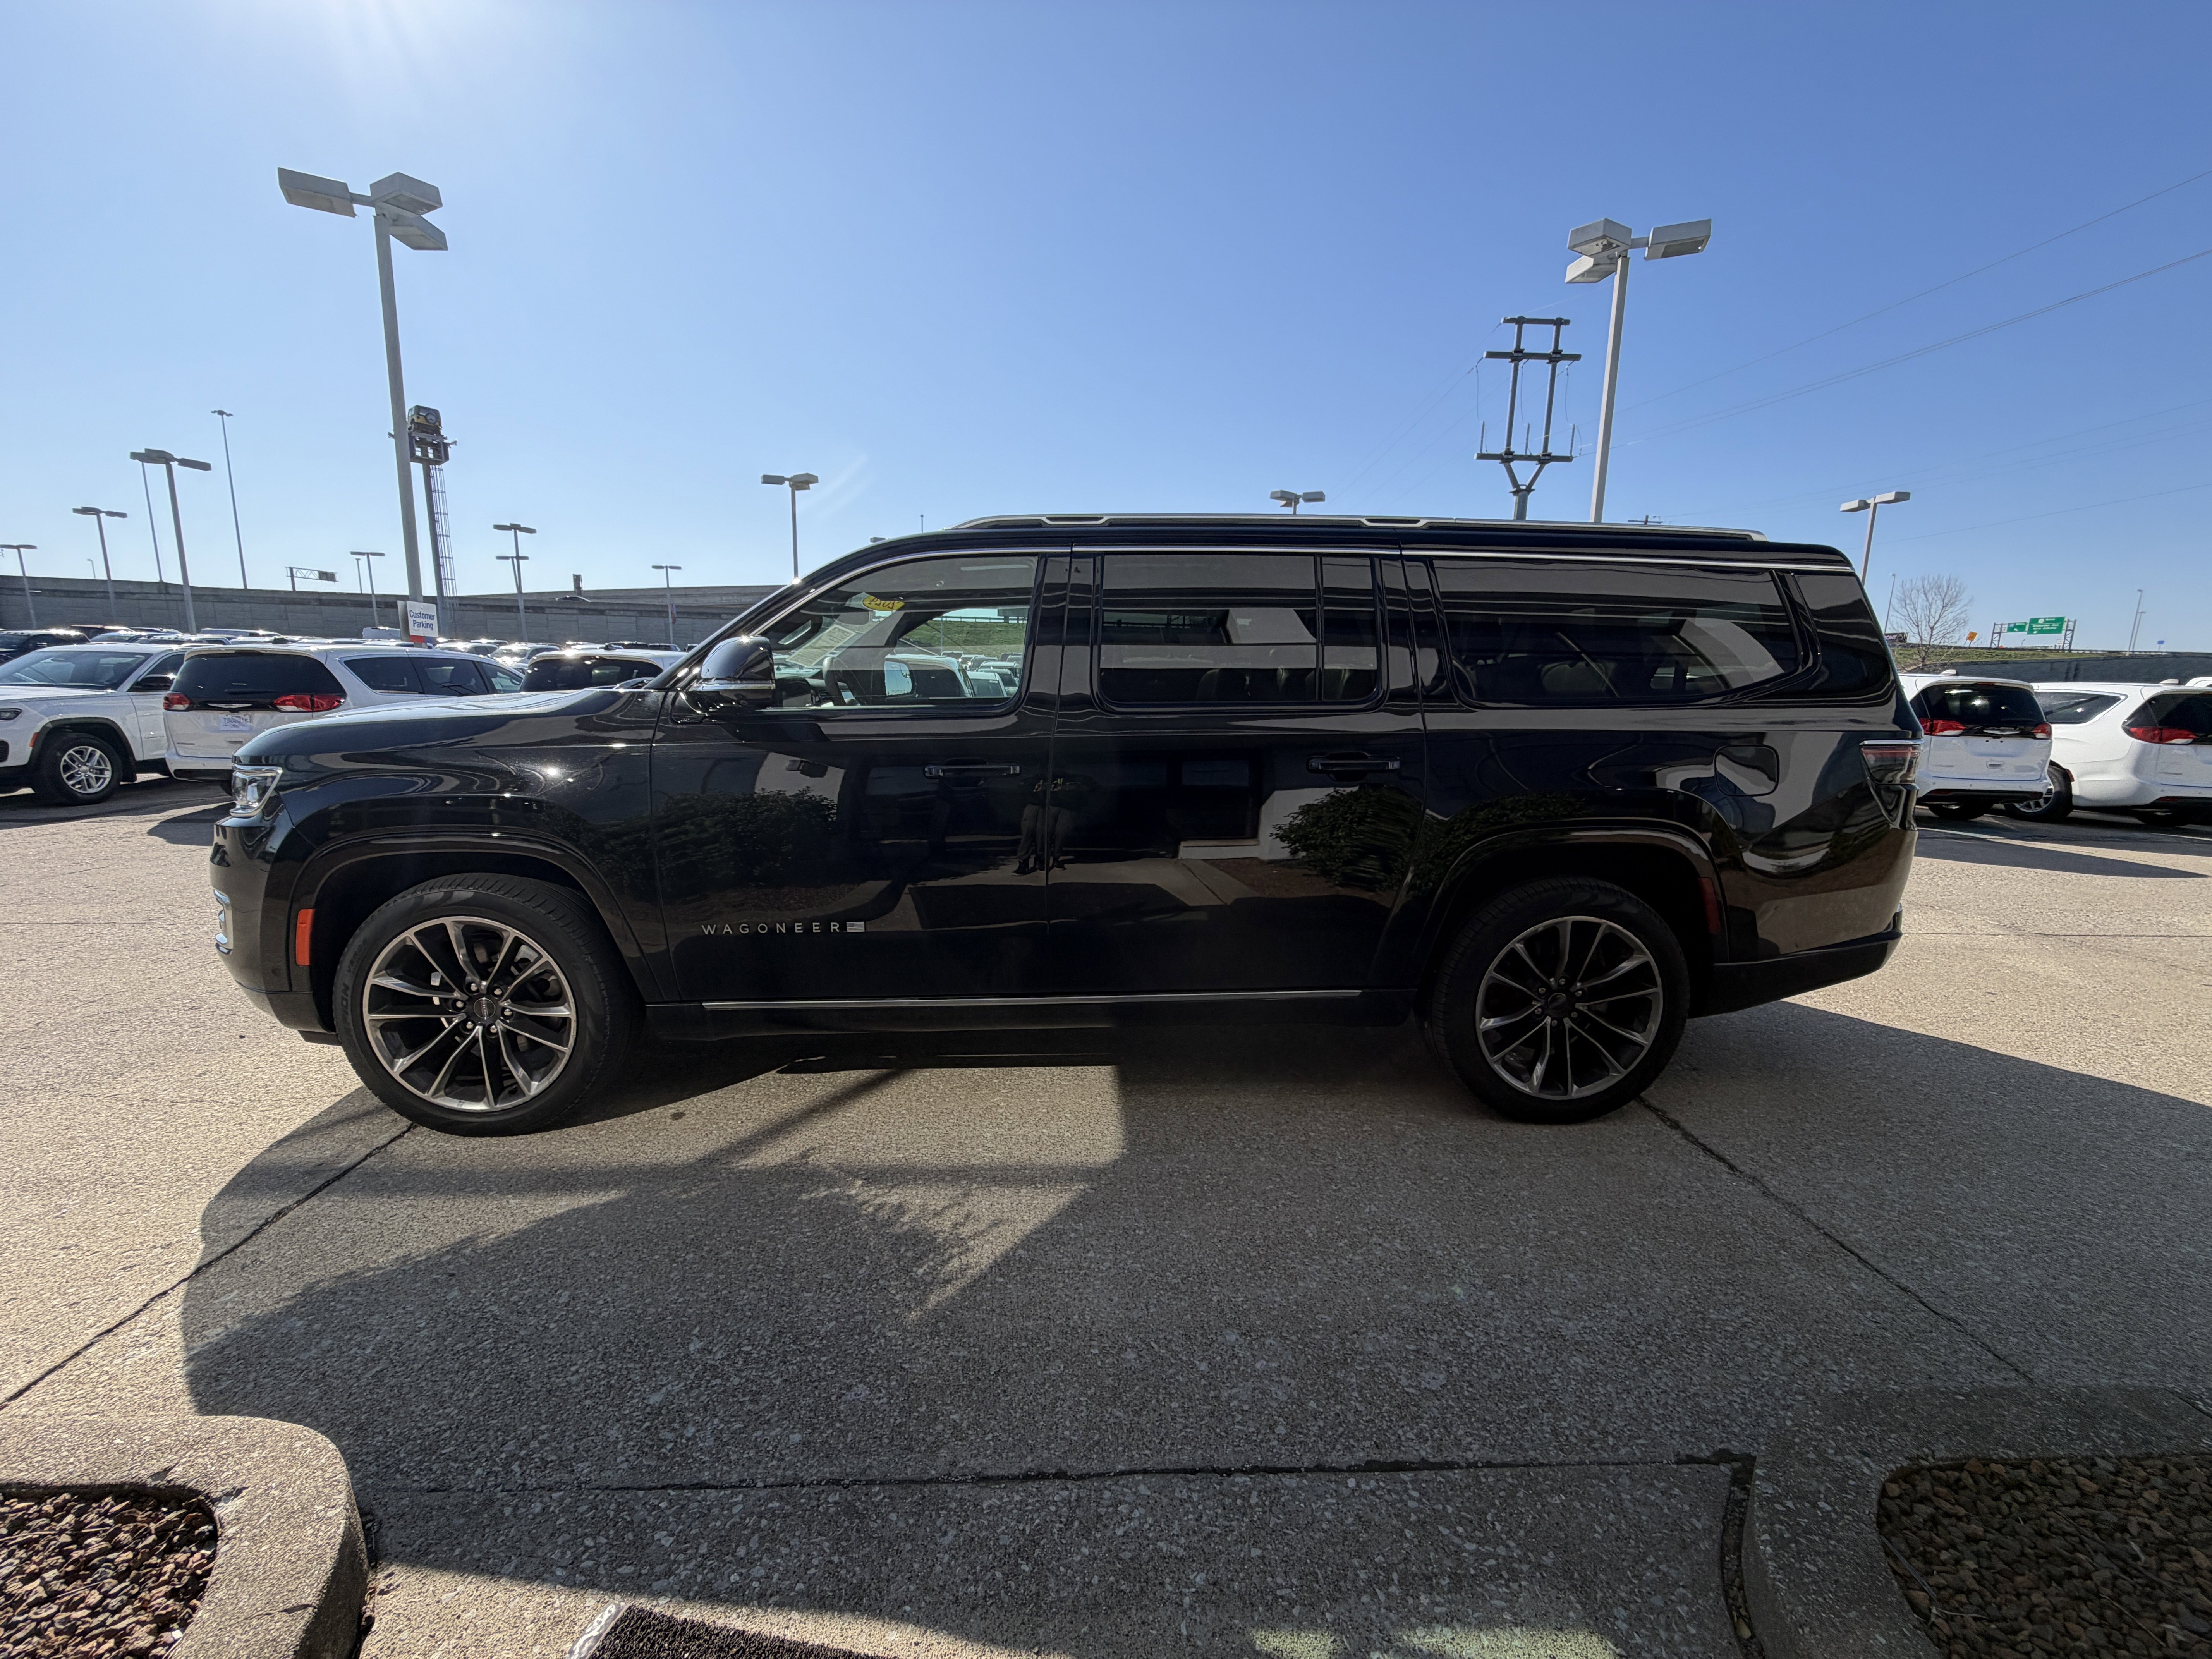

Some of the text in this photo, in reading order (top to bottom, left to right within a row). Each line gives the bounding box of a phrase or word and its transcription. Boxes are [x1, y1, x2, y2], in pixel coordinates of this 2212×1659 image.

[409, 610, 435, 620] Customer
[413, 619, 434, 631] Parking
[701, 922, 840, 934] WAGONEER
